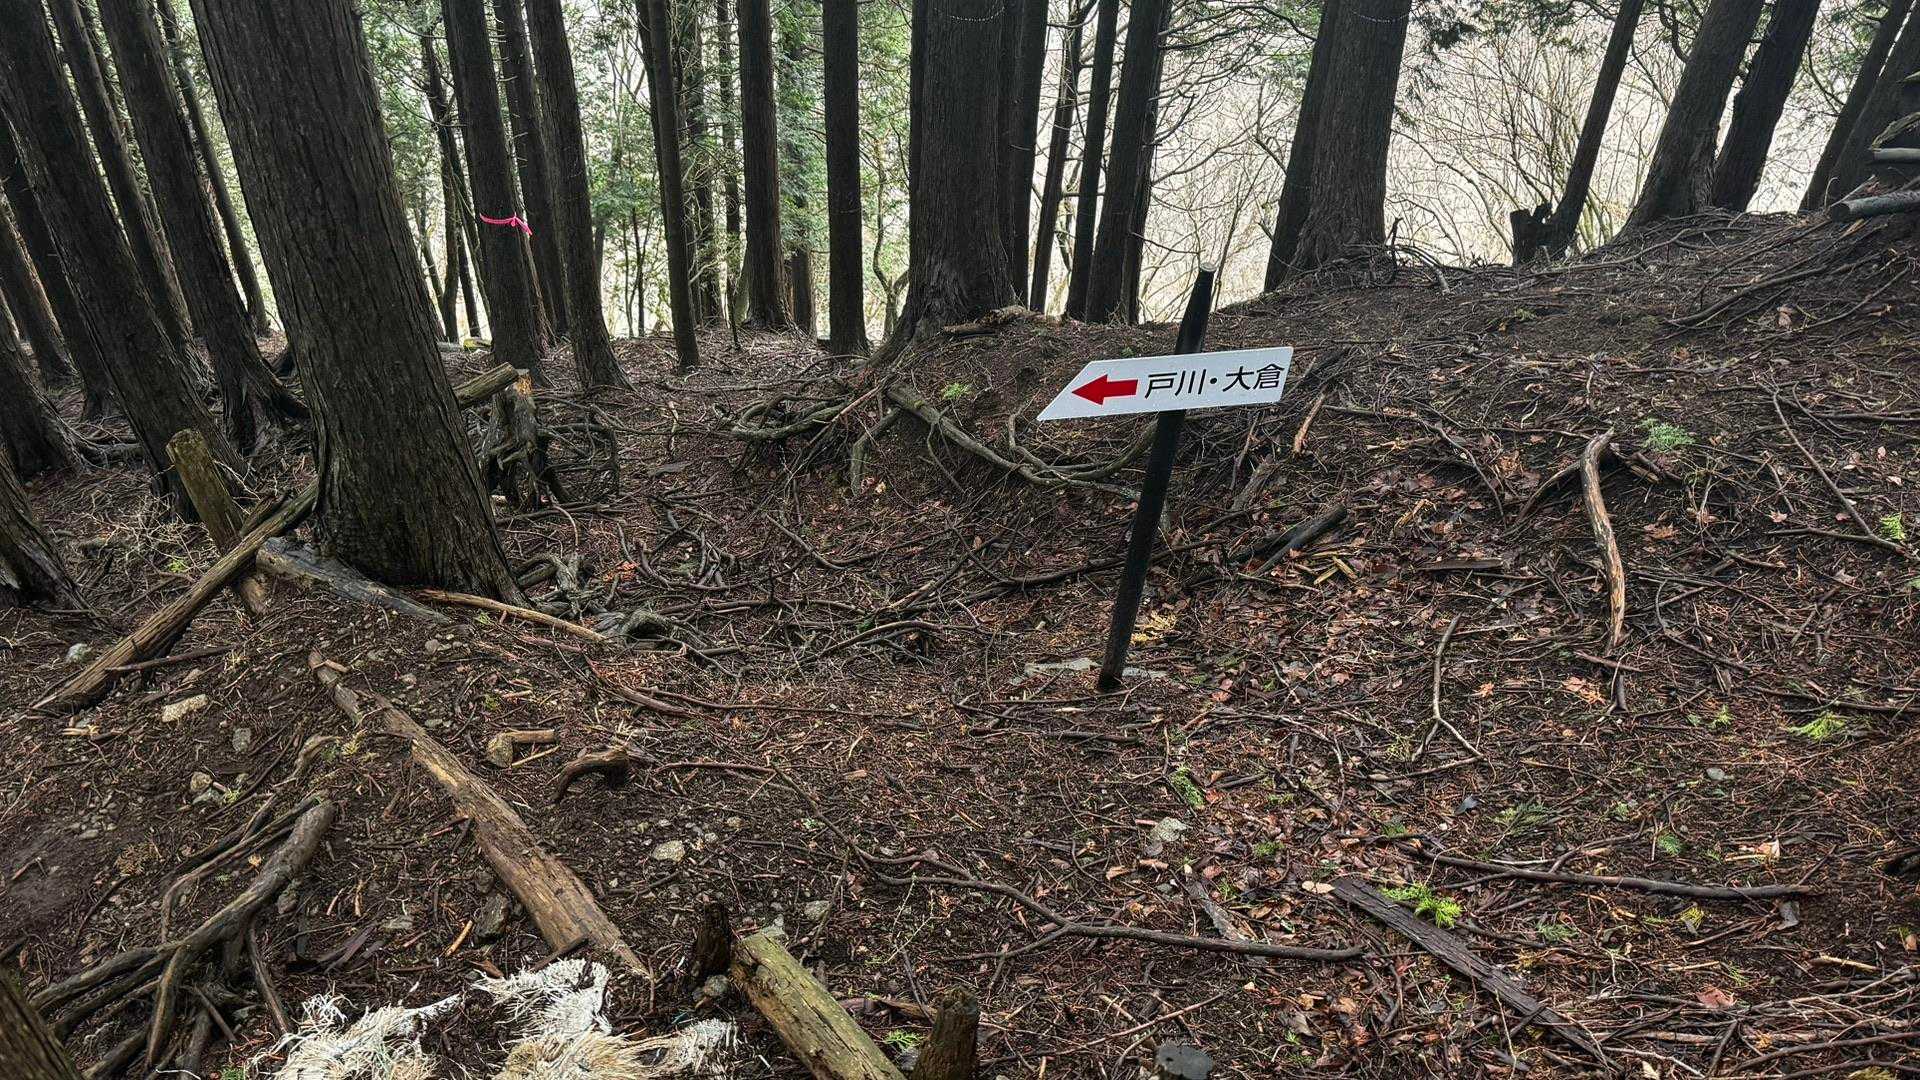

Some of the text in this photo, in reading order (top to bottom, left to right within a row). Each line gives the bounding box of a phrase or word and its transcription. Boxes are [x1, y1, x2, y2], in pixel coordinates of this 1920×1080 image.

[1144, 363, 1285, 399] 戸川・大倉
